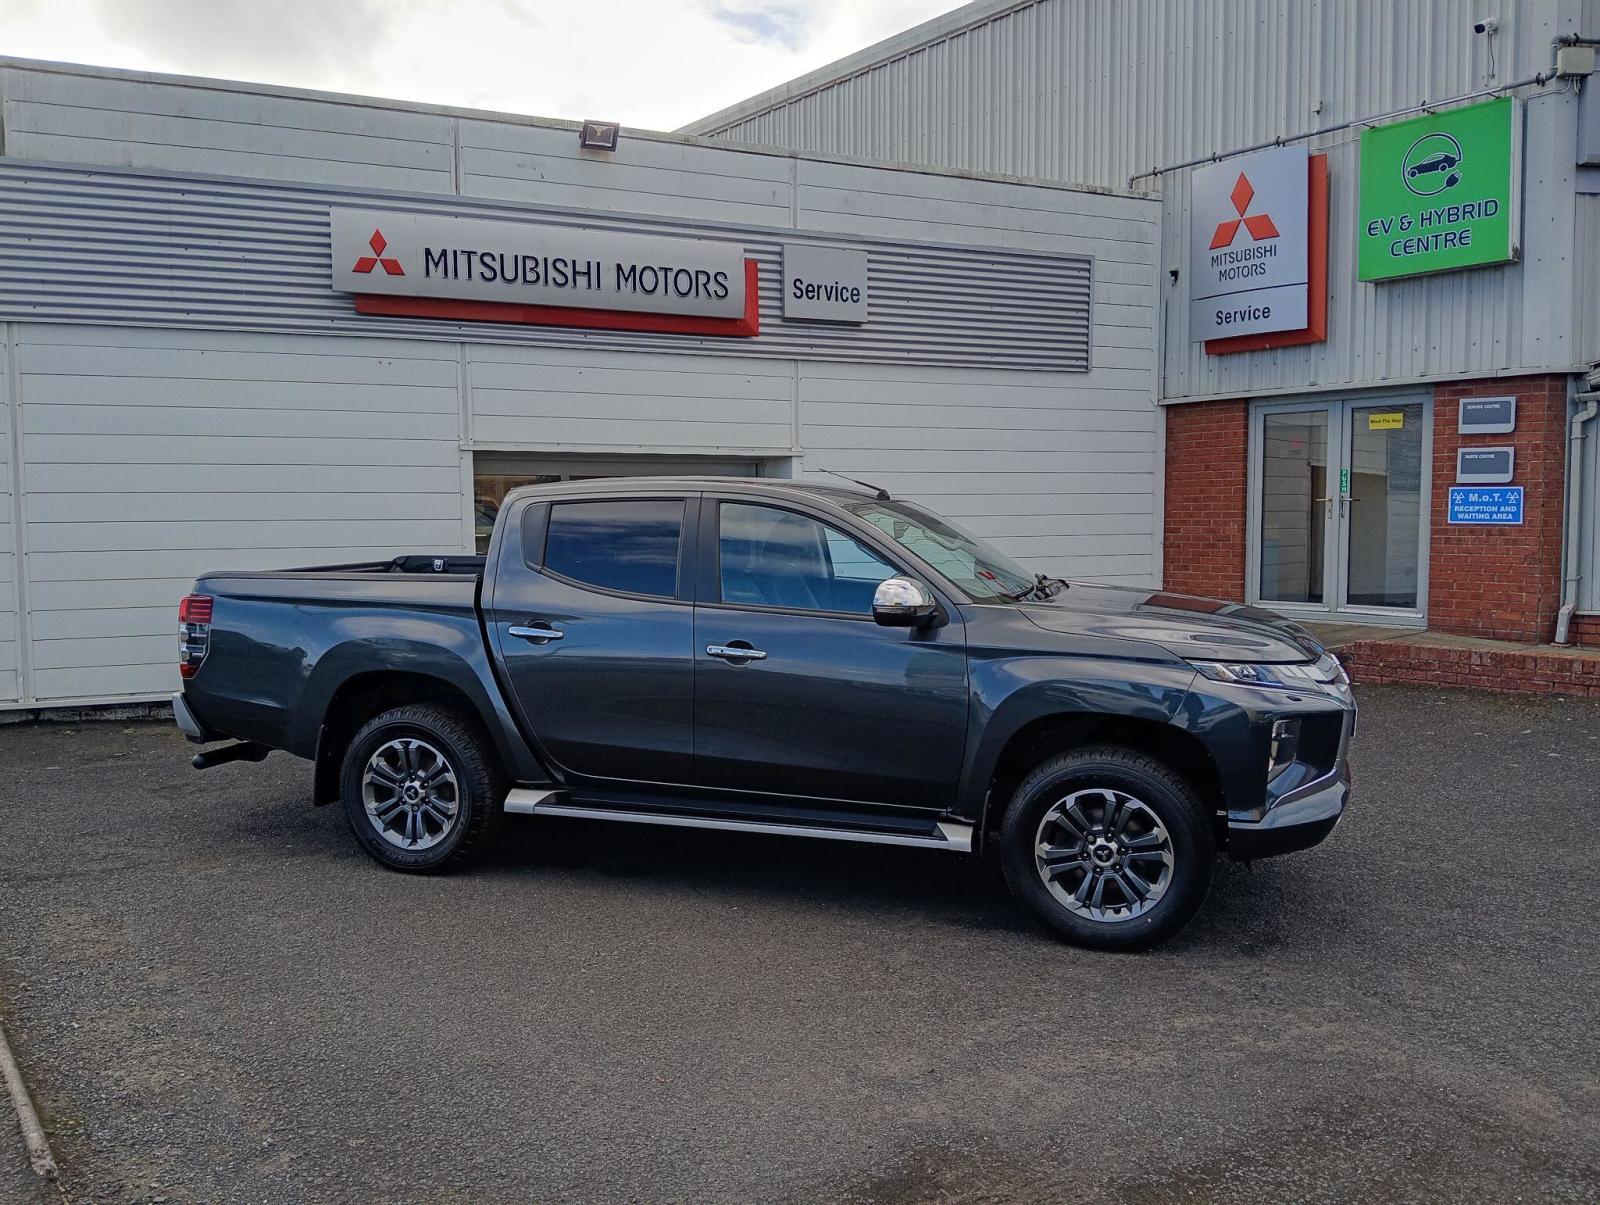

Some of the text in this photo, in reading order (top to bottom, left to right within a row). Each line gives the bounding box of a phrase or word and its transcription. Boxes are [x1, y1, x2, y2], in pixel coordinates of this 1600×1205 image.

[1368, 198, 1499, 237] EV & HYBRID
[1390, 228, 1472, 257] CENTRE
[1211, 244, 1277, 268] MITSUBISHI
[423, 246, 730, 300] MITSUBISHI MOTORS
[1219, 262, 1266, 282] MOTORS
[792, 277, 861, 304] Service
[1216, 304, 1271, 326] Service
[1468, 493, 1502, 502] M.o.T.
